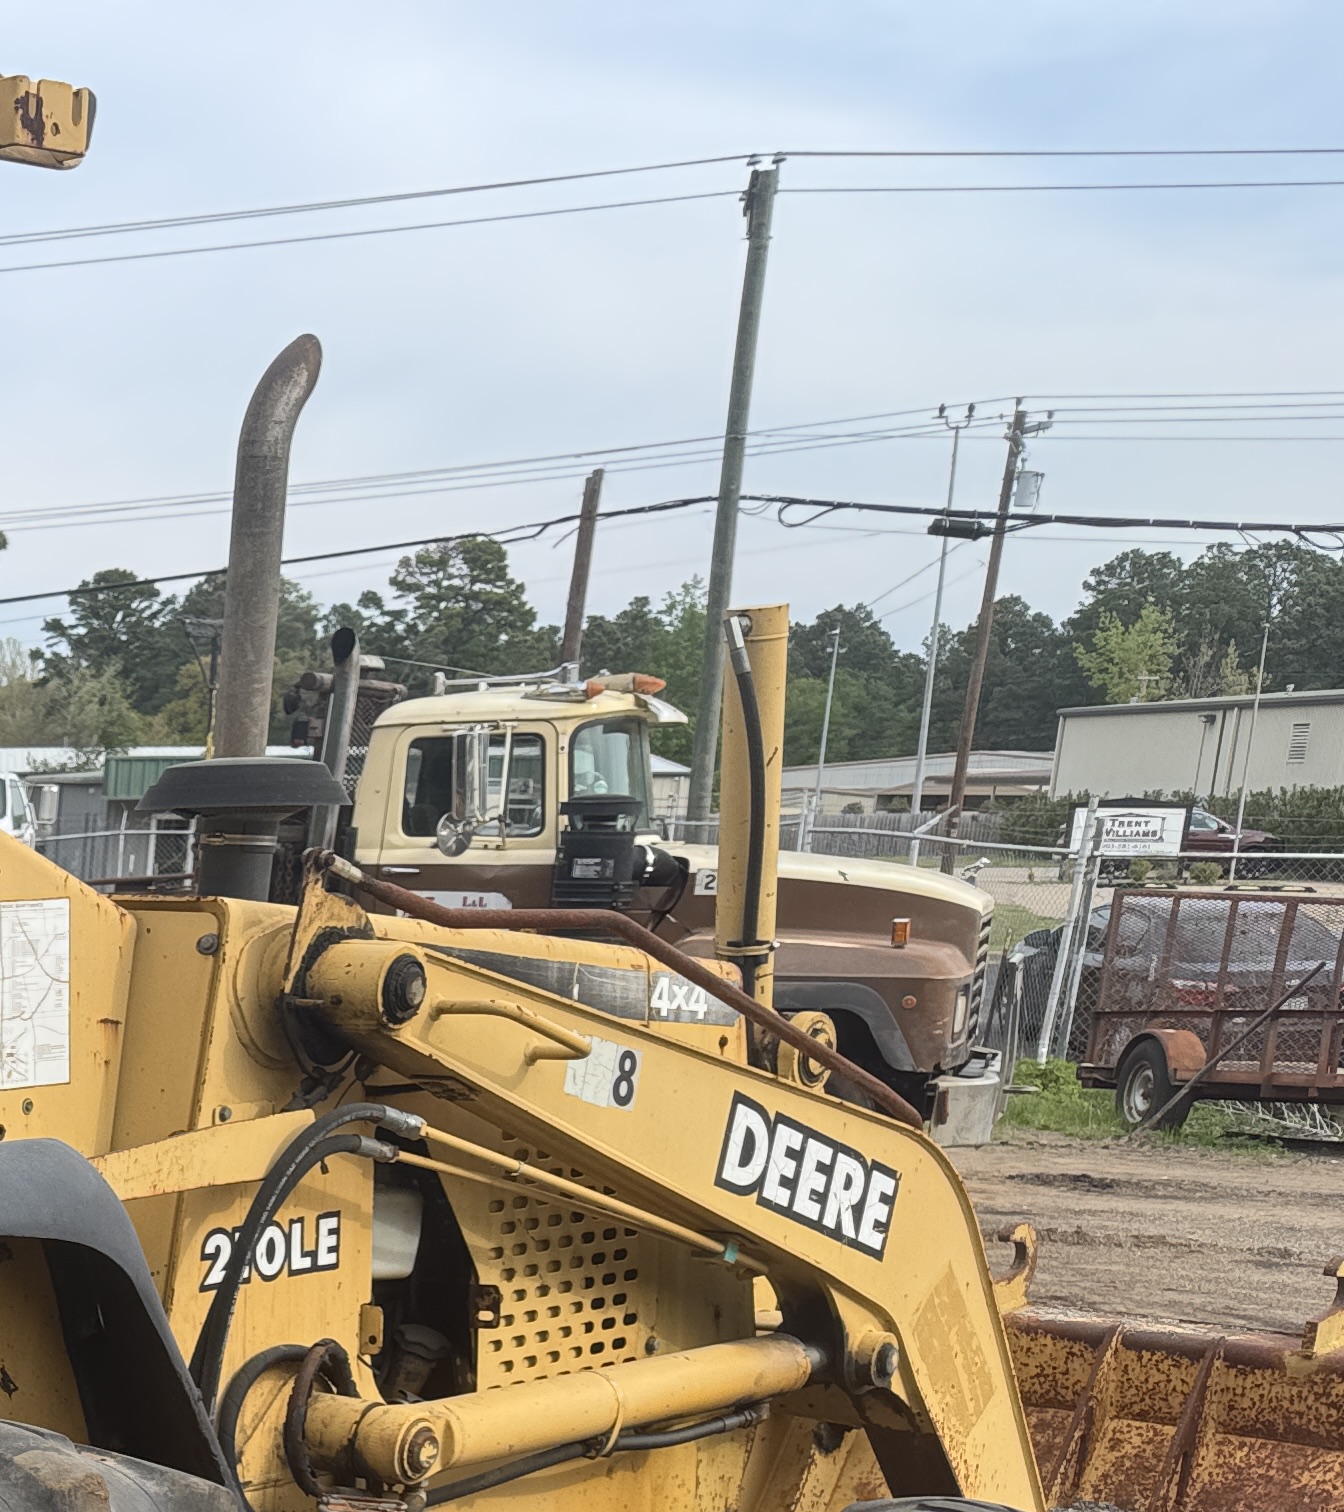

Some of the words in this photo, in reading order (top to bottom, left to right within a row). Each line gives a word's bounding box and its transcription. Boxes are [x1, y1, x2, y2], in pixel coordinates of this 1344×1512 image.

[1109, 819, 1151, 828] TRENT
[611, 1049, 638, 1108] 8
[720, 1102, 897, 1251] DEERE
[202, 1215, 340, 1287] 20LE
